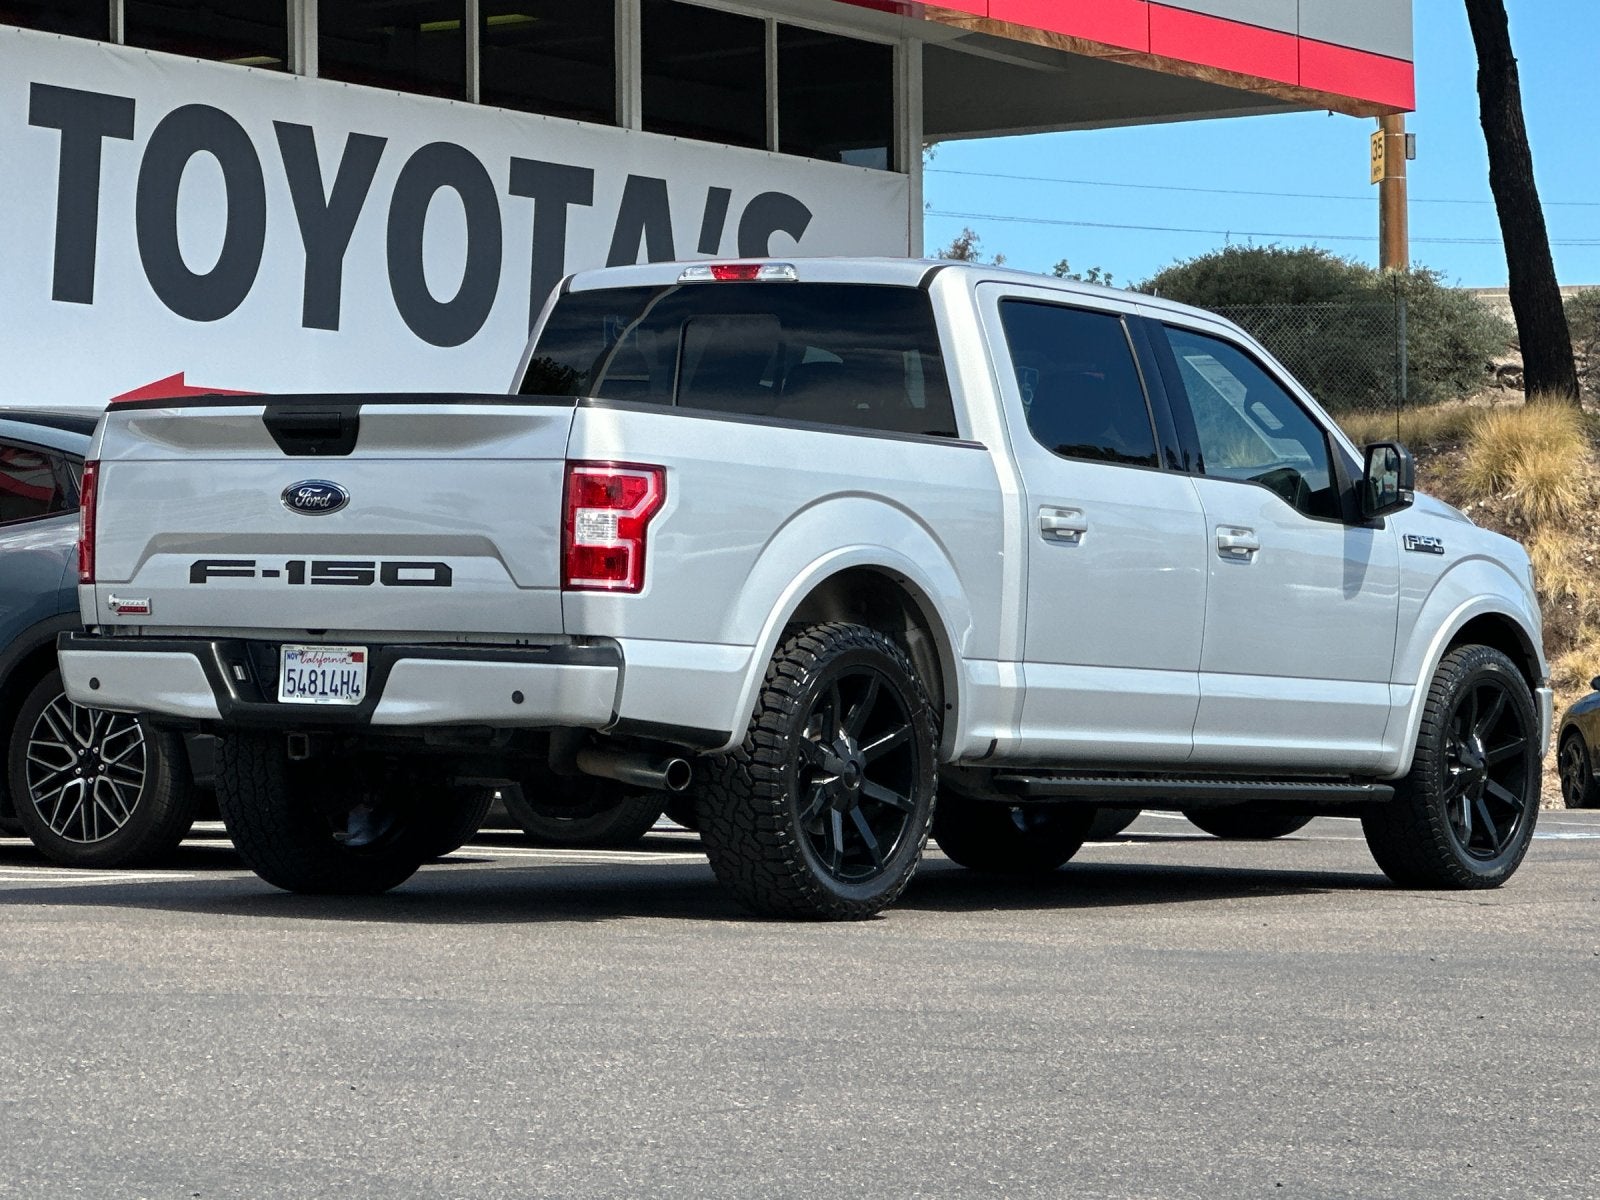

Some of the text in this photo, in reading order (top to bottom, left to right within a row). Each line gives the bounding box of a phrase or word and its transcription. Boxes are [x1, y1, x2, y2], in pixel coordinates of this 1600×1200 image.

[1372, 137, 1383, 162] 35
[294, 487, 332, 508] Ford
[189, 559, 453, 587] F-150
[301, 650, 347, 668] California
[287, 669, 360, 696] 54814H4
